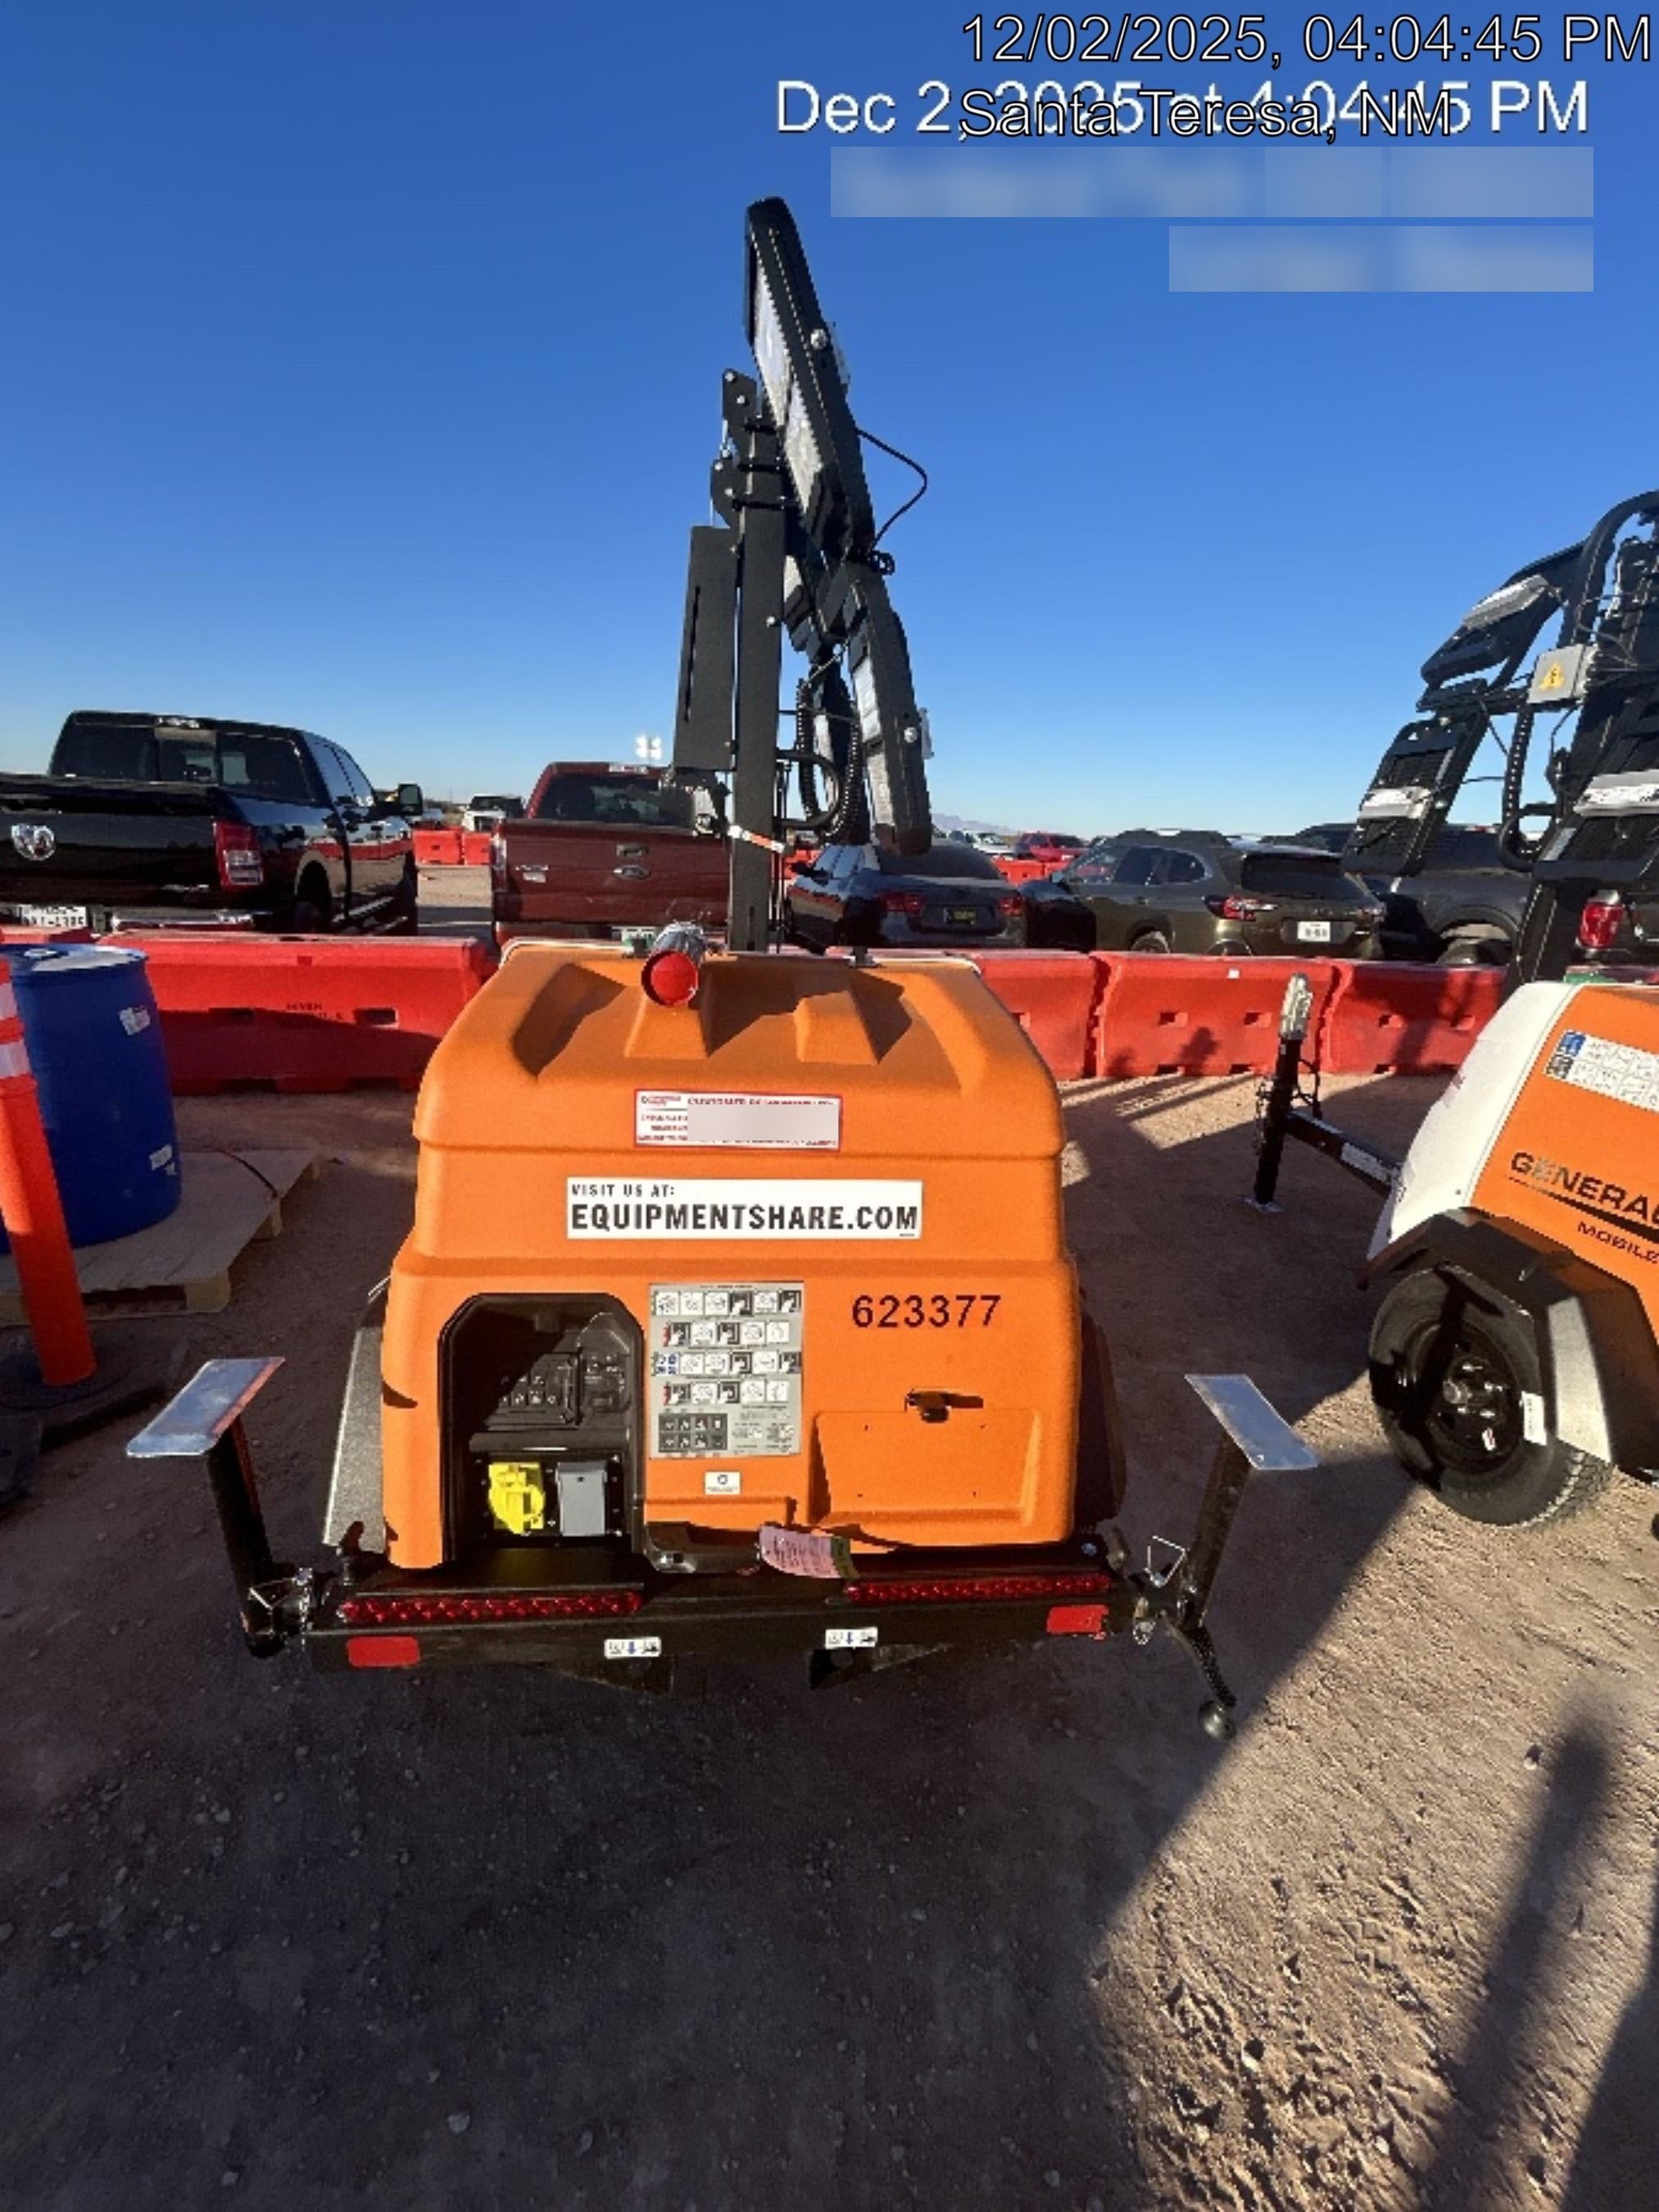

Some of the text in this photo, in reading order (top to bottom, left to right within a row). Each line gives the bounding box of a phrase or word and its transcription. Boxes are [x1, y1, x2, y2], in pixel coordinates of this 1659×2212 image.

[572, 1184, 675, 1198] VISIT US AT:
[572, 1203, 918, 1232] EQUIPMENTSHARE.COM
[851, 1294, 1002, 1329] 623377
